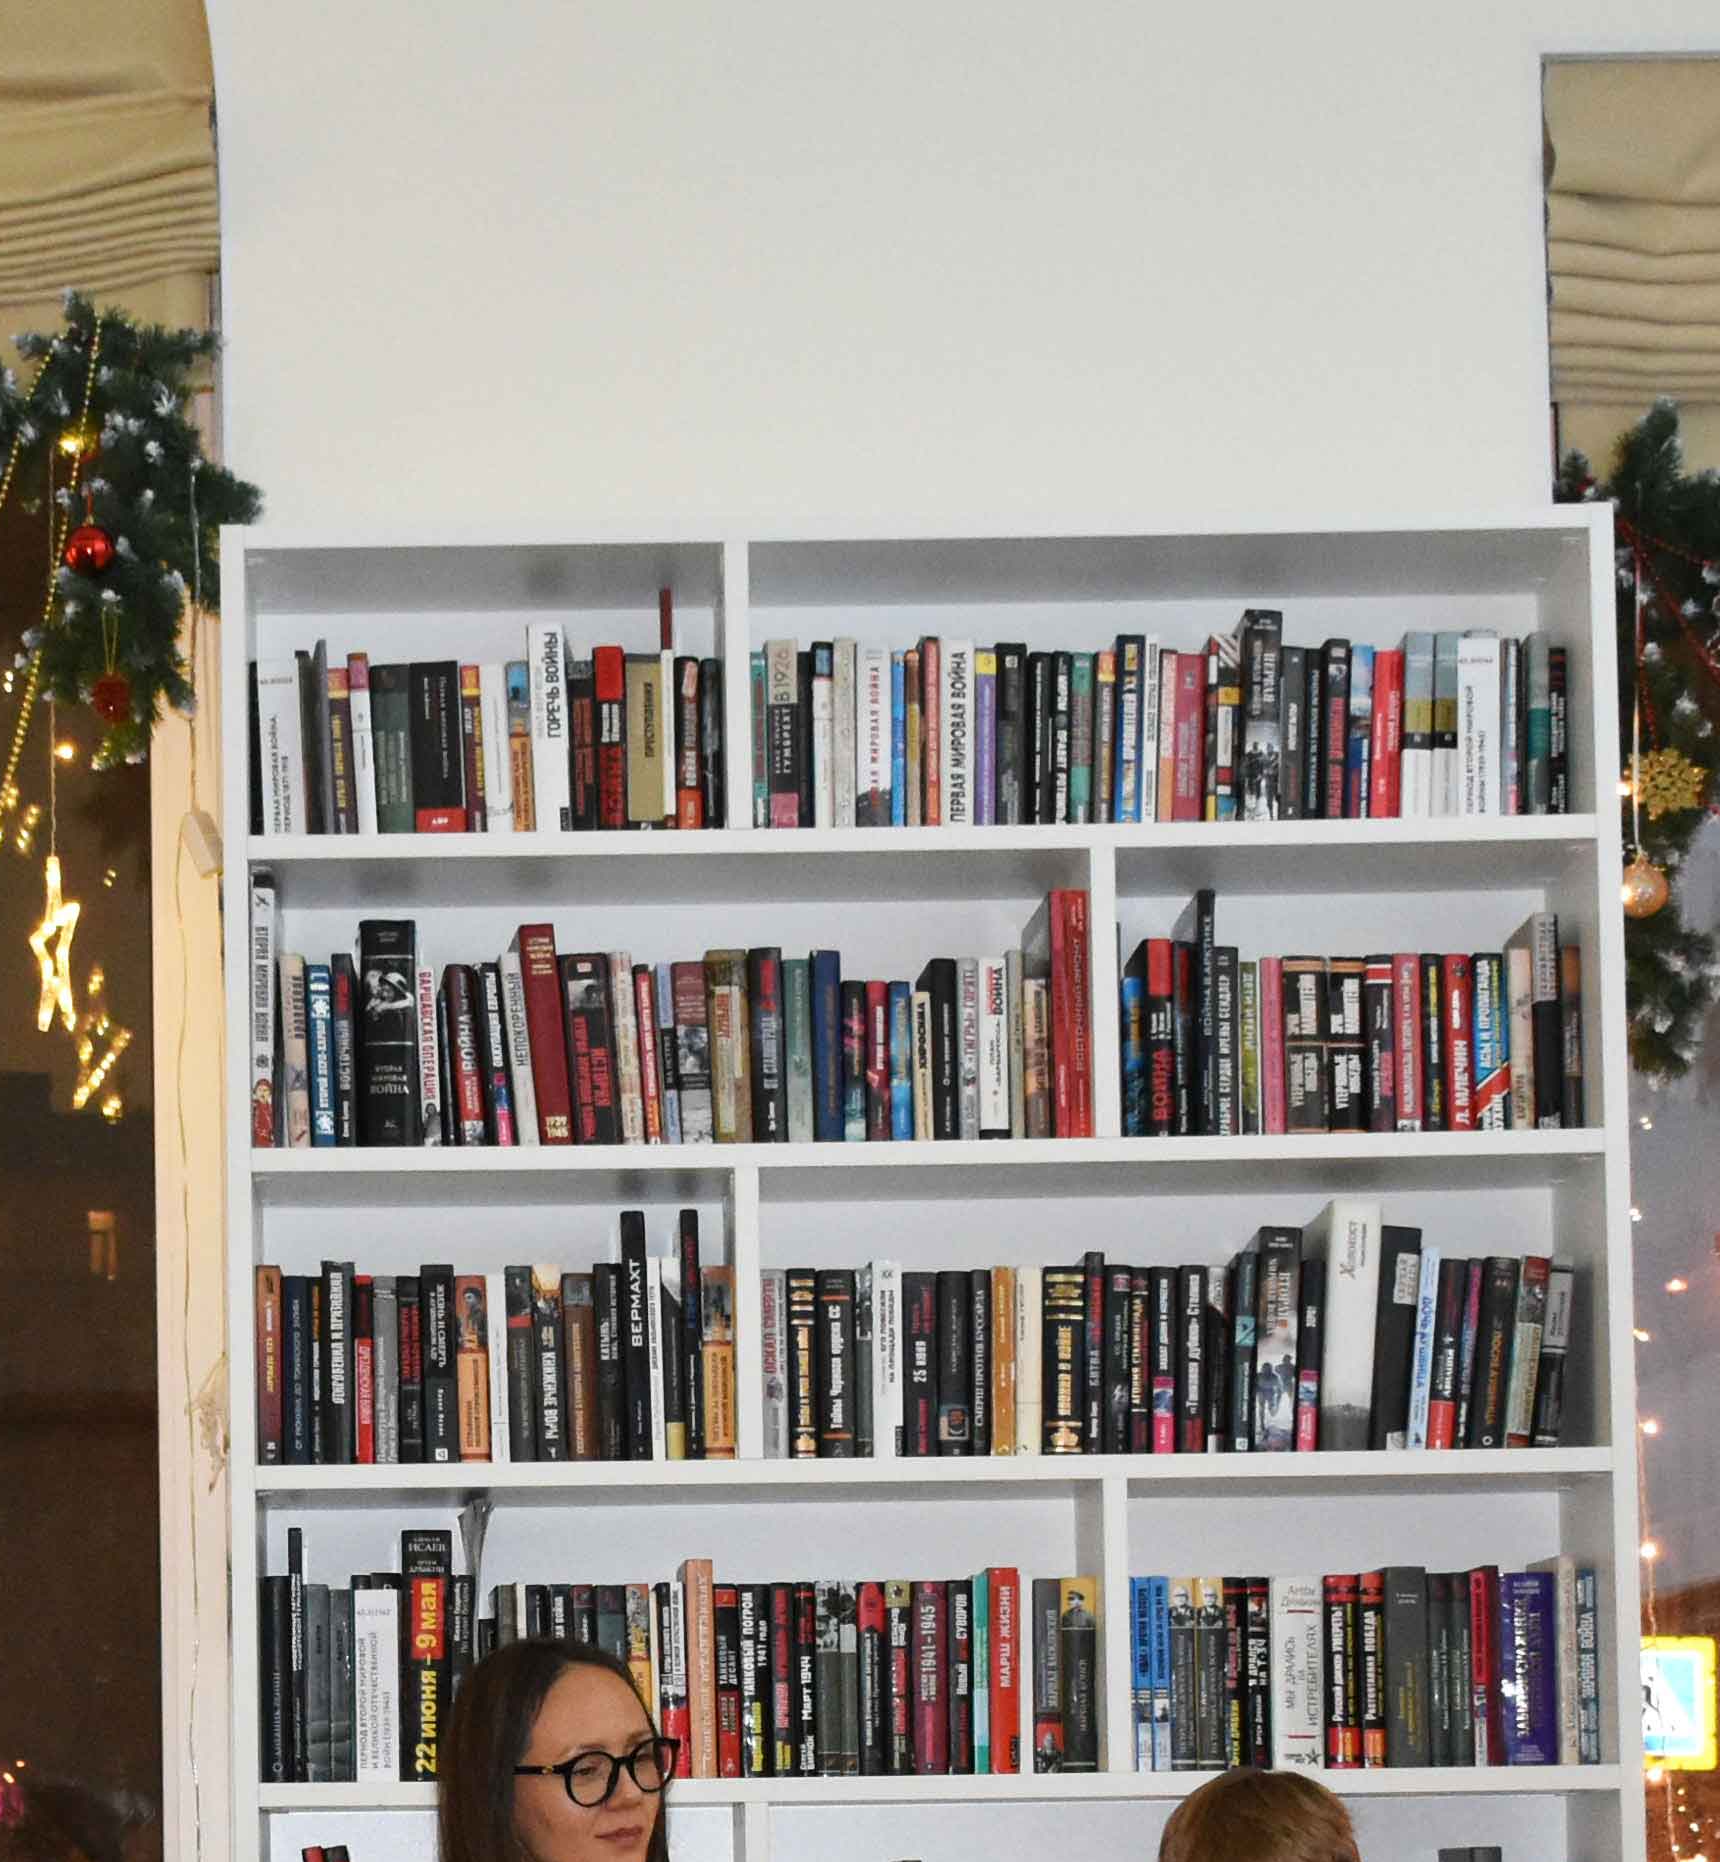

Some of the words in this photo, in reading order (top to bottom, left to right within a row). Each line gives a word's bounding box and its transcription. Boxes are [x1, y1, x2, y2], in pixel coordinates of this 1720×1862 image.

[540, 631, 559, 683] ВОЙНЫ
[947, 651, 966, 699] ВОЙНА
[544, 686, 561, 738] ГОРЕЧЬ
[781, 708, 792, 774] ГУМБРЕХТ
[950, 702, 966, 769] МИРОВАЯ
[950, 773, 966, 822] ПЕРВАЯ
[254, 927, 269, 961] ВТОРАЯ
[254, 965, 269, 1009] МИРОВАЯ
[418, 971, 434, 1042] ВАРШАВСКАЯ
[484, 972, 499, 1010] ЕВРОПЫ
[991, 966, 1004, 1016] ВОЙНА
[1217, 974, 1231, 1019] СЕНДЛЕР
[1296, 973, 1317, 1035] МАНШТЕЙН
[1342, 978, 1360, 1034] МАНШТЕЙН
[1475, 960, 1491, 1030] ПРОПАГАНДА
[254, 1012, 271, 1042] ВОЙНА
[486, 1012, 503, 1067] ОККУПАЦИЯ
[506, 973, 529, 1066] НЕПОКОРЕННЫЙ
[916, 1001, 927, 1070] ХИРОСИМА
[1218, 1021, 1232, 1054] ИРЕНЫ
[1286, 1013, 1299, 1035] ЭРИХ
[335, 1019, 351, 1090] ВОСТОЧНЫЙ
[422, 1045, 436, 1101] ОПЕРАЦИЯ
[1219, 1058, 1233, 1093] СЕРДЦЕ
[1304, 1052, 1317, 1092] ПОБЕДЫ
[1348, 1054, 1361, 1094] ПОБЕДЫ
[1453, 1040, 1469, 1106] МЛЕЧИН
[1478, 1042, 1493, 1068] АСЫ
[370, 1083, 410, 1095] ВОЙНА
[591, 1047, 610, 1107] ИСТОРИЯ
[1152, 1048, 1168, 1121] ВОЙНА
[1289, 1052, 1304, 1108] УТЕРЯННЫЕ
[1334, 1054, 1348, 1109] УТЕРЯННЫЕ
[1455, 1108, 1470, 1124] Л.
[329, 1271, 343, 1330] ПРИЗНАНИЯ
[435, 1283, 445, 1320] ЖИЗНЬ
[628, 1258, 643, 1347] ВЕРМАХТ
[828, 1304, 841, 1319] СС
[974, 1289, 984, 1342] БУССАРДА
[1187, 1274, 1200, 1316] Сталина
[1420, 1296, 1434, 1329] ДОЧЬ
[437, 1330, 446, 1368] СМЕРТЬ
[600, 1317, 610, 1360] КАТЫНЬ:
[829, 1322, 844, 1355] ордена
[914, 1340, 927, 1366] июня
[1131, 1299, 1142, 1364] СТАЛИНГРАДА
[1186, 1317, 1201, 1360] дубина»
[331, 1341, 345, 1404] ОТКРОВЕНИЯ
[541, 1351, 557, 1407] КНИЖНЫЕ
[829, 1357, 844, 1396] Черного
[913, 1369, 927, 1383] 25
[974, 1344, 984, 1386] ПРОТИВ
[1089, 1348, 1101, 1386] БИТВА
[1132, 1367, 1142, 1405] АГОНИЯ
[974, 1388, 985, 1426] СМЕРШ
[1186, 1361, 1200, 1414] «Танковая
[544, 1409, 558, 1439] ВОРЫ
[830, 1399, 843, 1429] Тайны
[407, 1543, 446, 1553] ИСАЕВ
[416, 1581, 436, 1630] мая
[741, 1592, 753, 1635] ПОГРОМ
[955, 1593, 969, 1640] СУВОРОВ
[999, 1585, 1011, 1638] ЖИЗНИ
[415, 1631, 436, 1648] 9
[758, 1619, 767, 1641] года
[920, 1605, 938, 1673] 1941-1945
[1330, 1606, 1342, 1652] УМЕРЕТЬ!
[1362, 1610, 1375, 1652] ПОБЕДА
[1577, 1612, 1594, 1649] ВОЙНА
[717, 1635, 727, 1685] ТАНКОВЫЙ
[728, 1650, 737, 1685] ДЕСАНТ
[741, 1639, 754, 1696] ТАНКОВЫЙ
[756, 1644, 767, 1667] 1941
[800, 1655, 811, 1684] 1944
[999, 1643, 1011, 1688] МАРШ
[1248, 1638, 1258, 1676] ДРАЛСЯ
[1284, 1636, 1296, 1685] ДРАЛИСЬ
[1305, 1624, 1319, 1726] ИСТРЕБИТЕЛЯХ
[954, 1663, 969, 1695] Новый
[1284, 1688, 1296, 1709] МЫ
[358, 1688, 368, 1728] ВТОРОЙ
[418, 1670, 436, 1738] июня
[1331, 1685, 1344, 1721] Русский
[358, 1729, 368, 1769] ПЕРИОД
[370, 1714, 379, 1760] ВЕЛИКОЙ
[415, 1743, 437, 1773] 22
